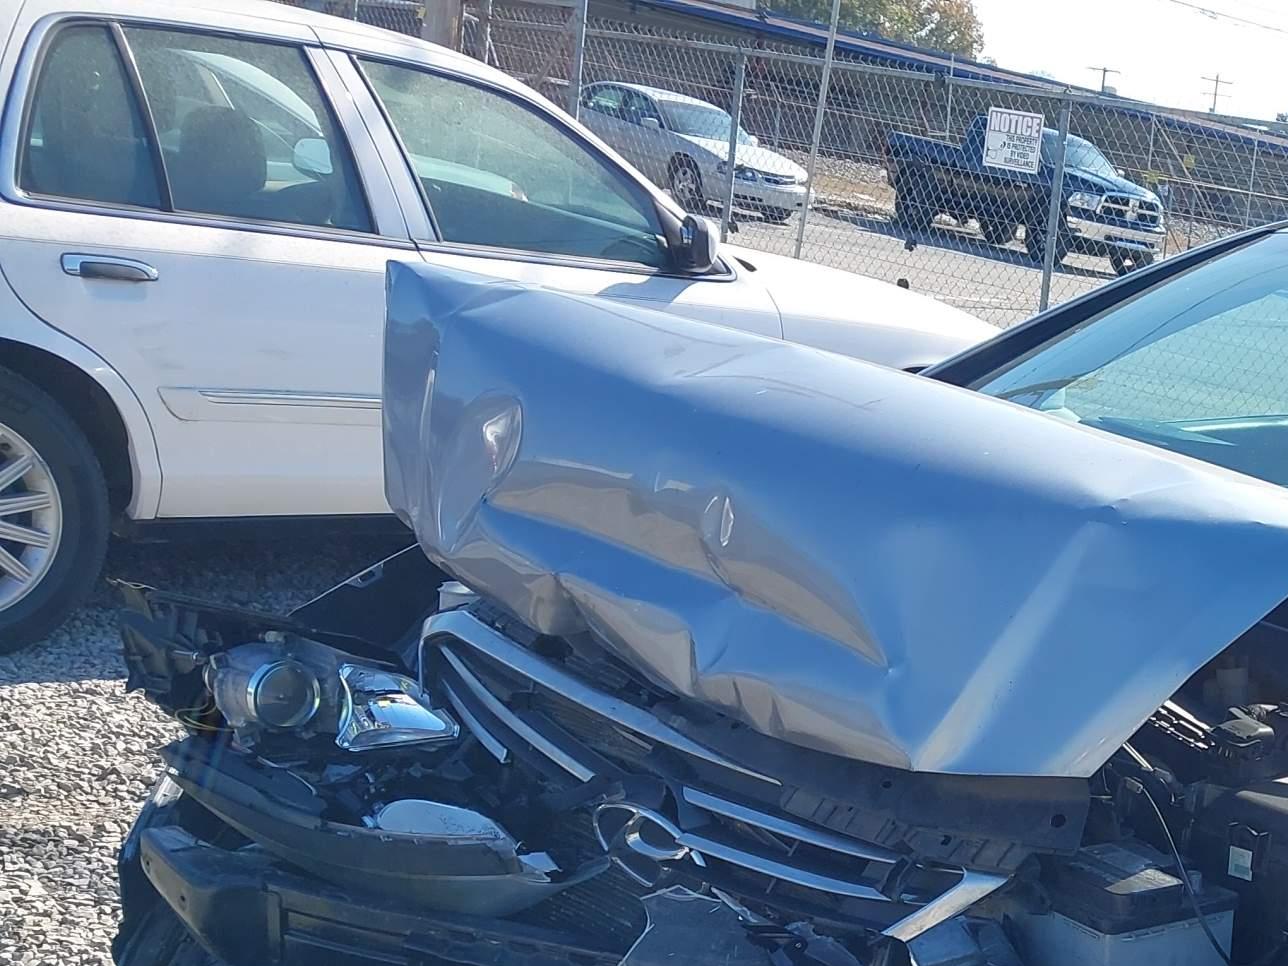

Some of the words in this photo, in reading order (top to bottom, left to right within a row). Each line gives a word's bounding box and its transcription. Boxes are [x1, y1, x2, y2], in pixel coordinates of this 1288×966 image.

[990, 111, 1041, 137] NOTICE
[1006, 134, 1015, 142] THIS
[1015, 136, 1037, 145] PROPERTY
[1011, 143, 1036, 152] PROTECTED
[1016, 151, 1029, 160] VIDEO
[1004, 157, 1034, 168] SURVEILLANCE
